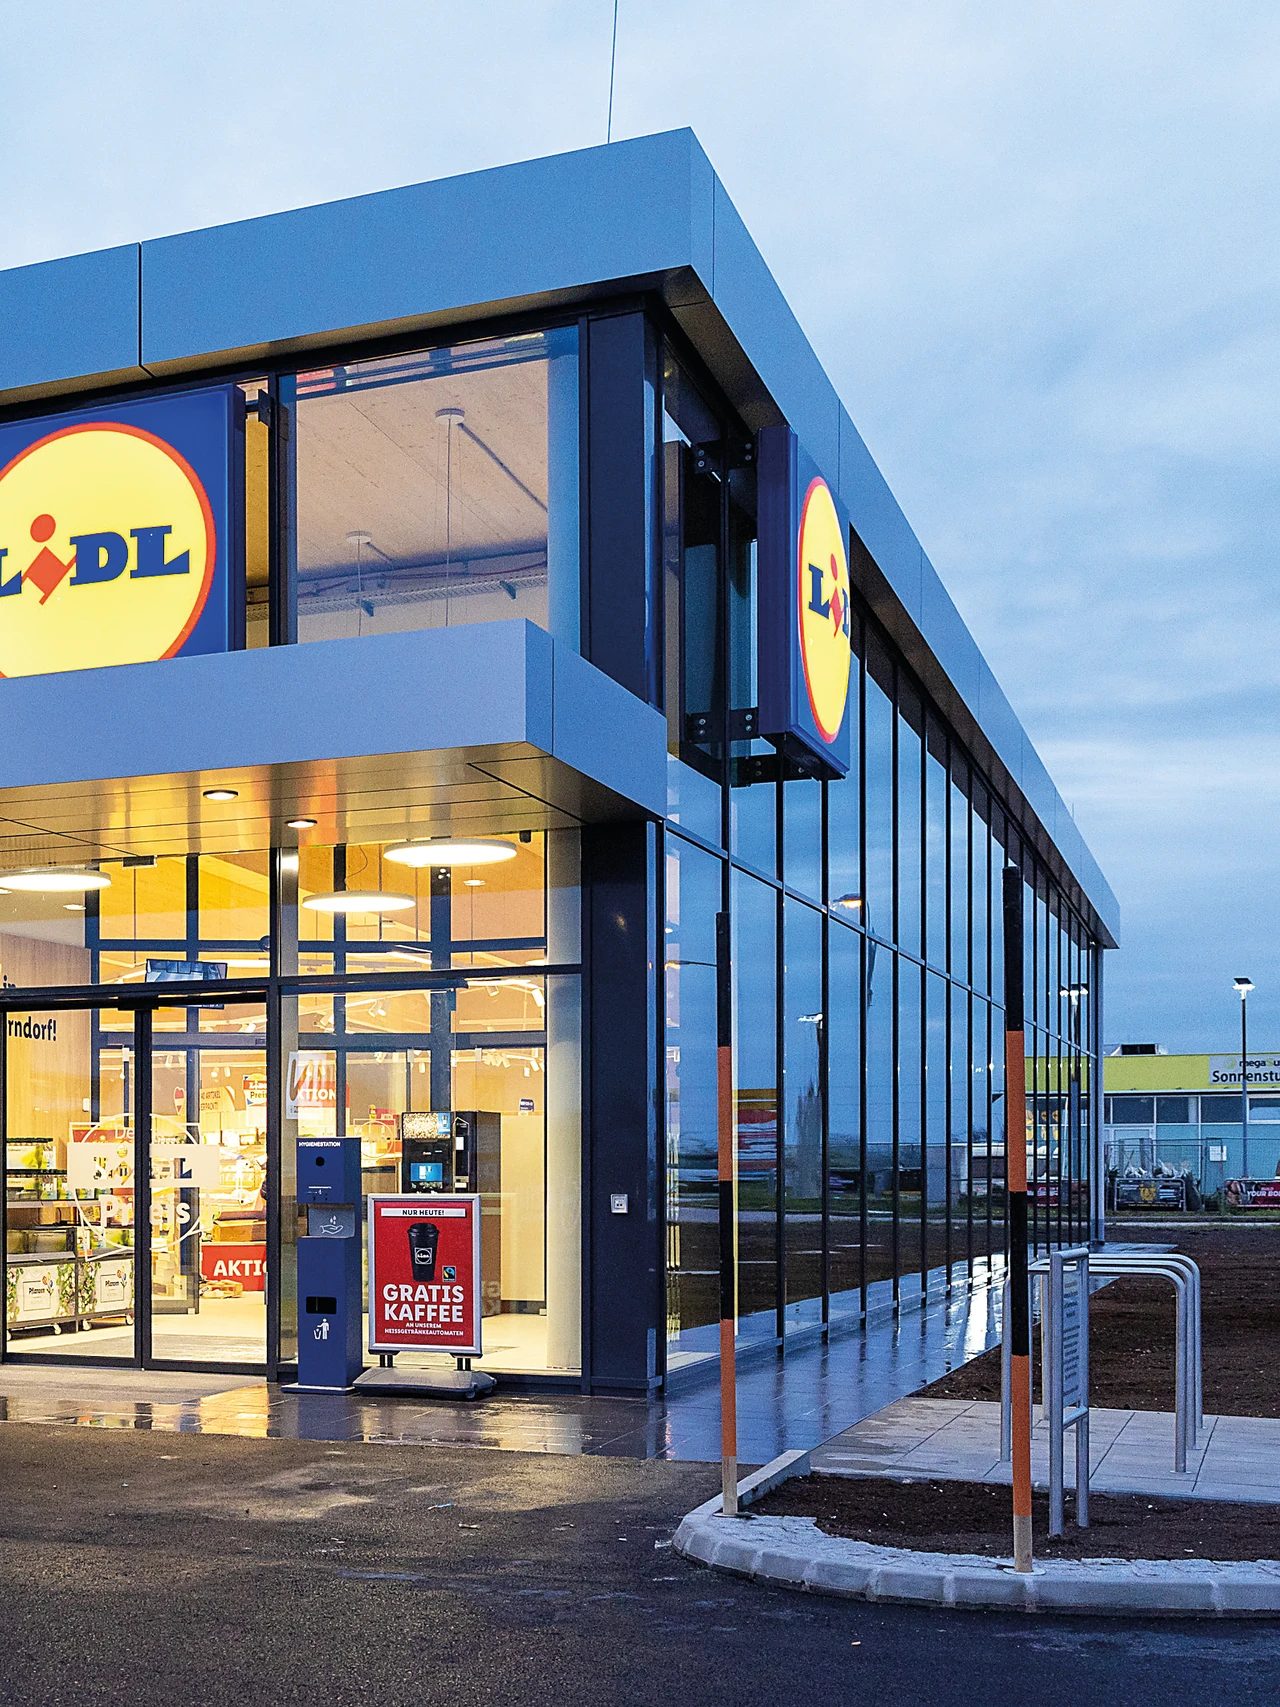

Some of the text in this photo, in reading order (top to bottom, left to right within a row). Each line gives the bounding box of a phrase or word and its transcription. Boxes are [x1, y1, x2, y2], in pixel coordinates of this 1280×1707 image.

[250, 1090, 267, 1100] Prei
[297, 1088, 336, 1101] KTION
[114, 1125, 134, 1140] De
[383, 1284, 464, 1303] GRATIS
[384, 1303, 464, 1323] KAFFEE
